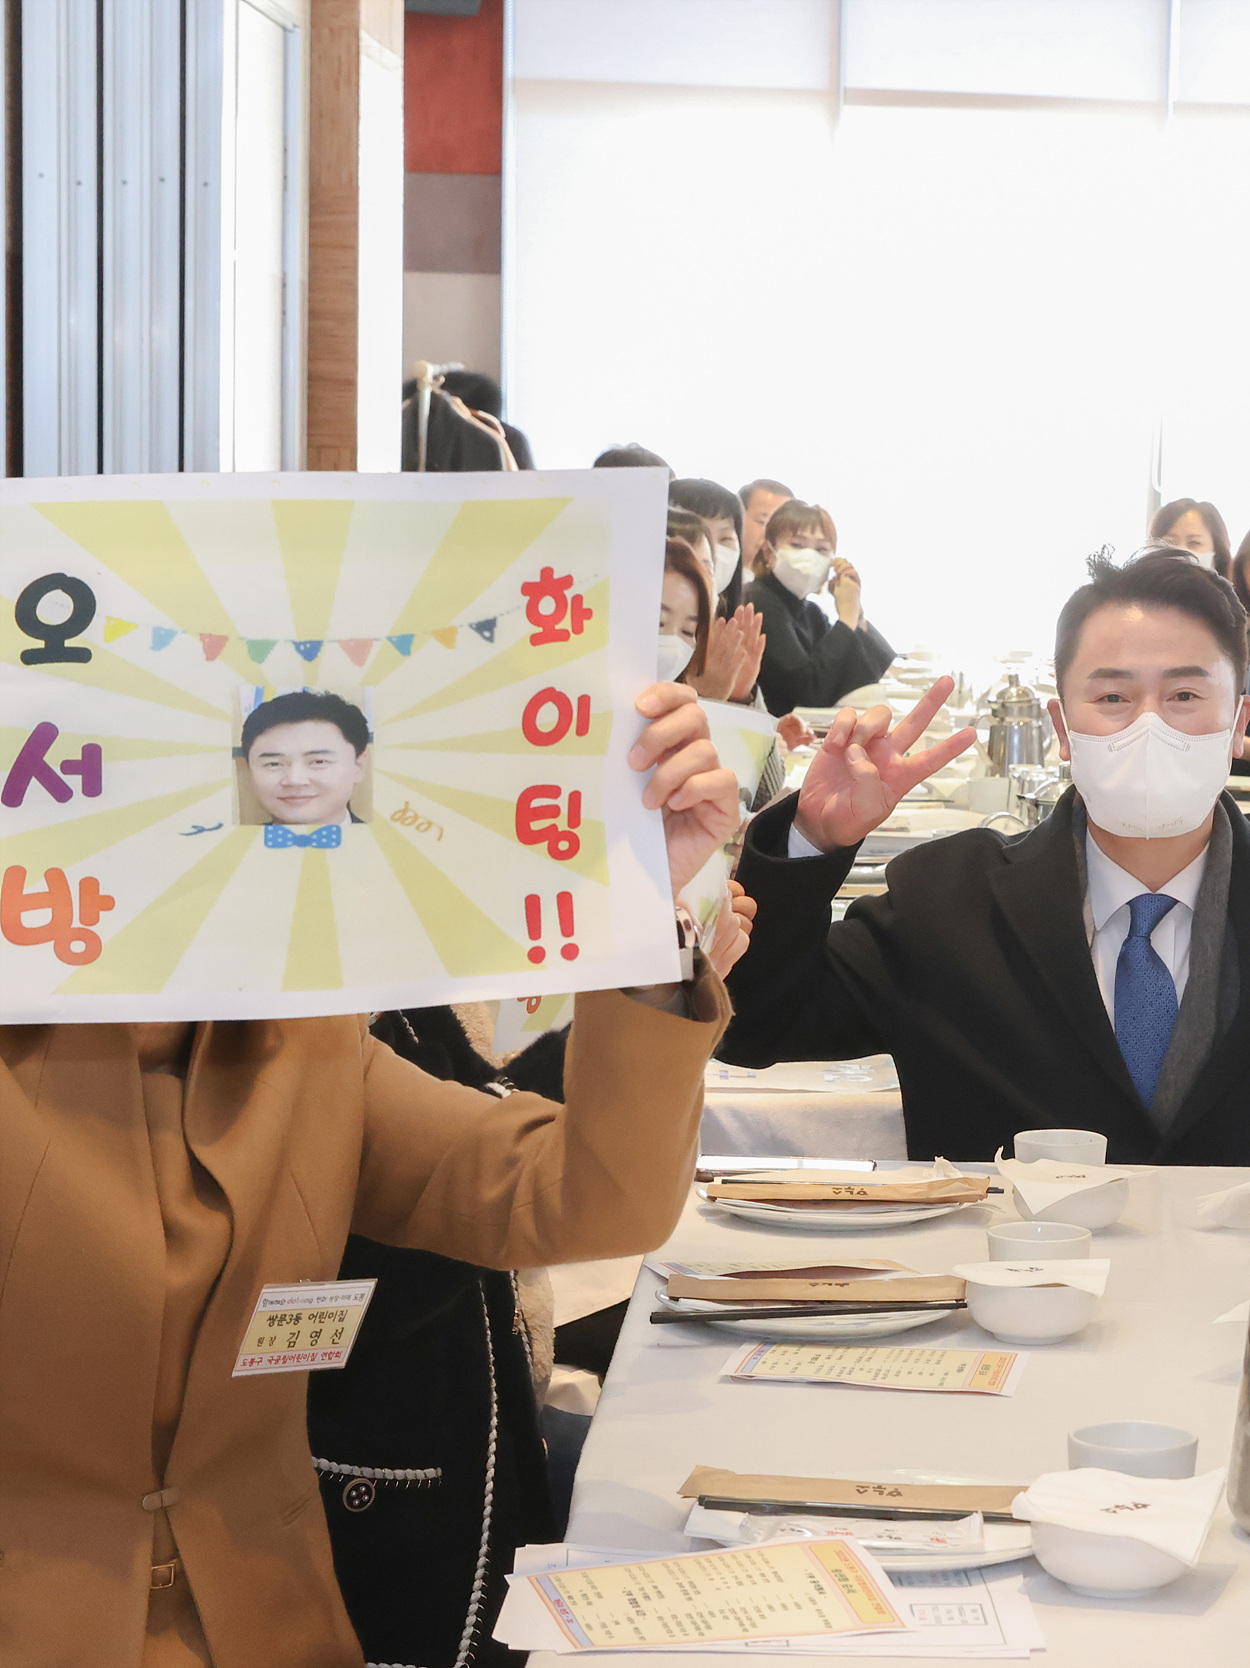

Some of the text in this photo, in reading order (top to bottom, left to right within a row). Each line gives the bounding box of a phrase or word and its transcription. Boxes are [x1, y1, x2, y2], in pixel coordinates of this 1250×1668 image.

[1, 572, 116, 967] 오서방
[514, 566, 594, 965] 화이팅!!
[240, 1356, 263, 1368] 도봉구
[267, 1352, 318, 1366] 국공립어린이집
[266, 1309, 349, 1327] 쌍문3동 어린이집
